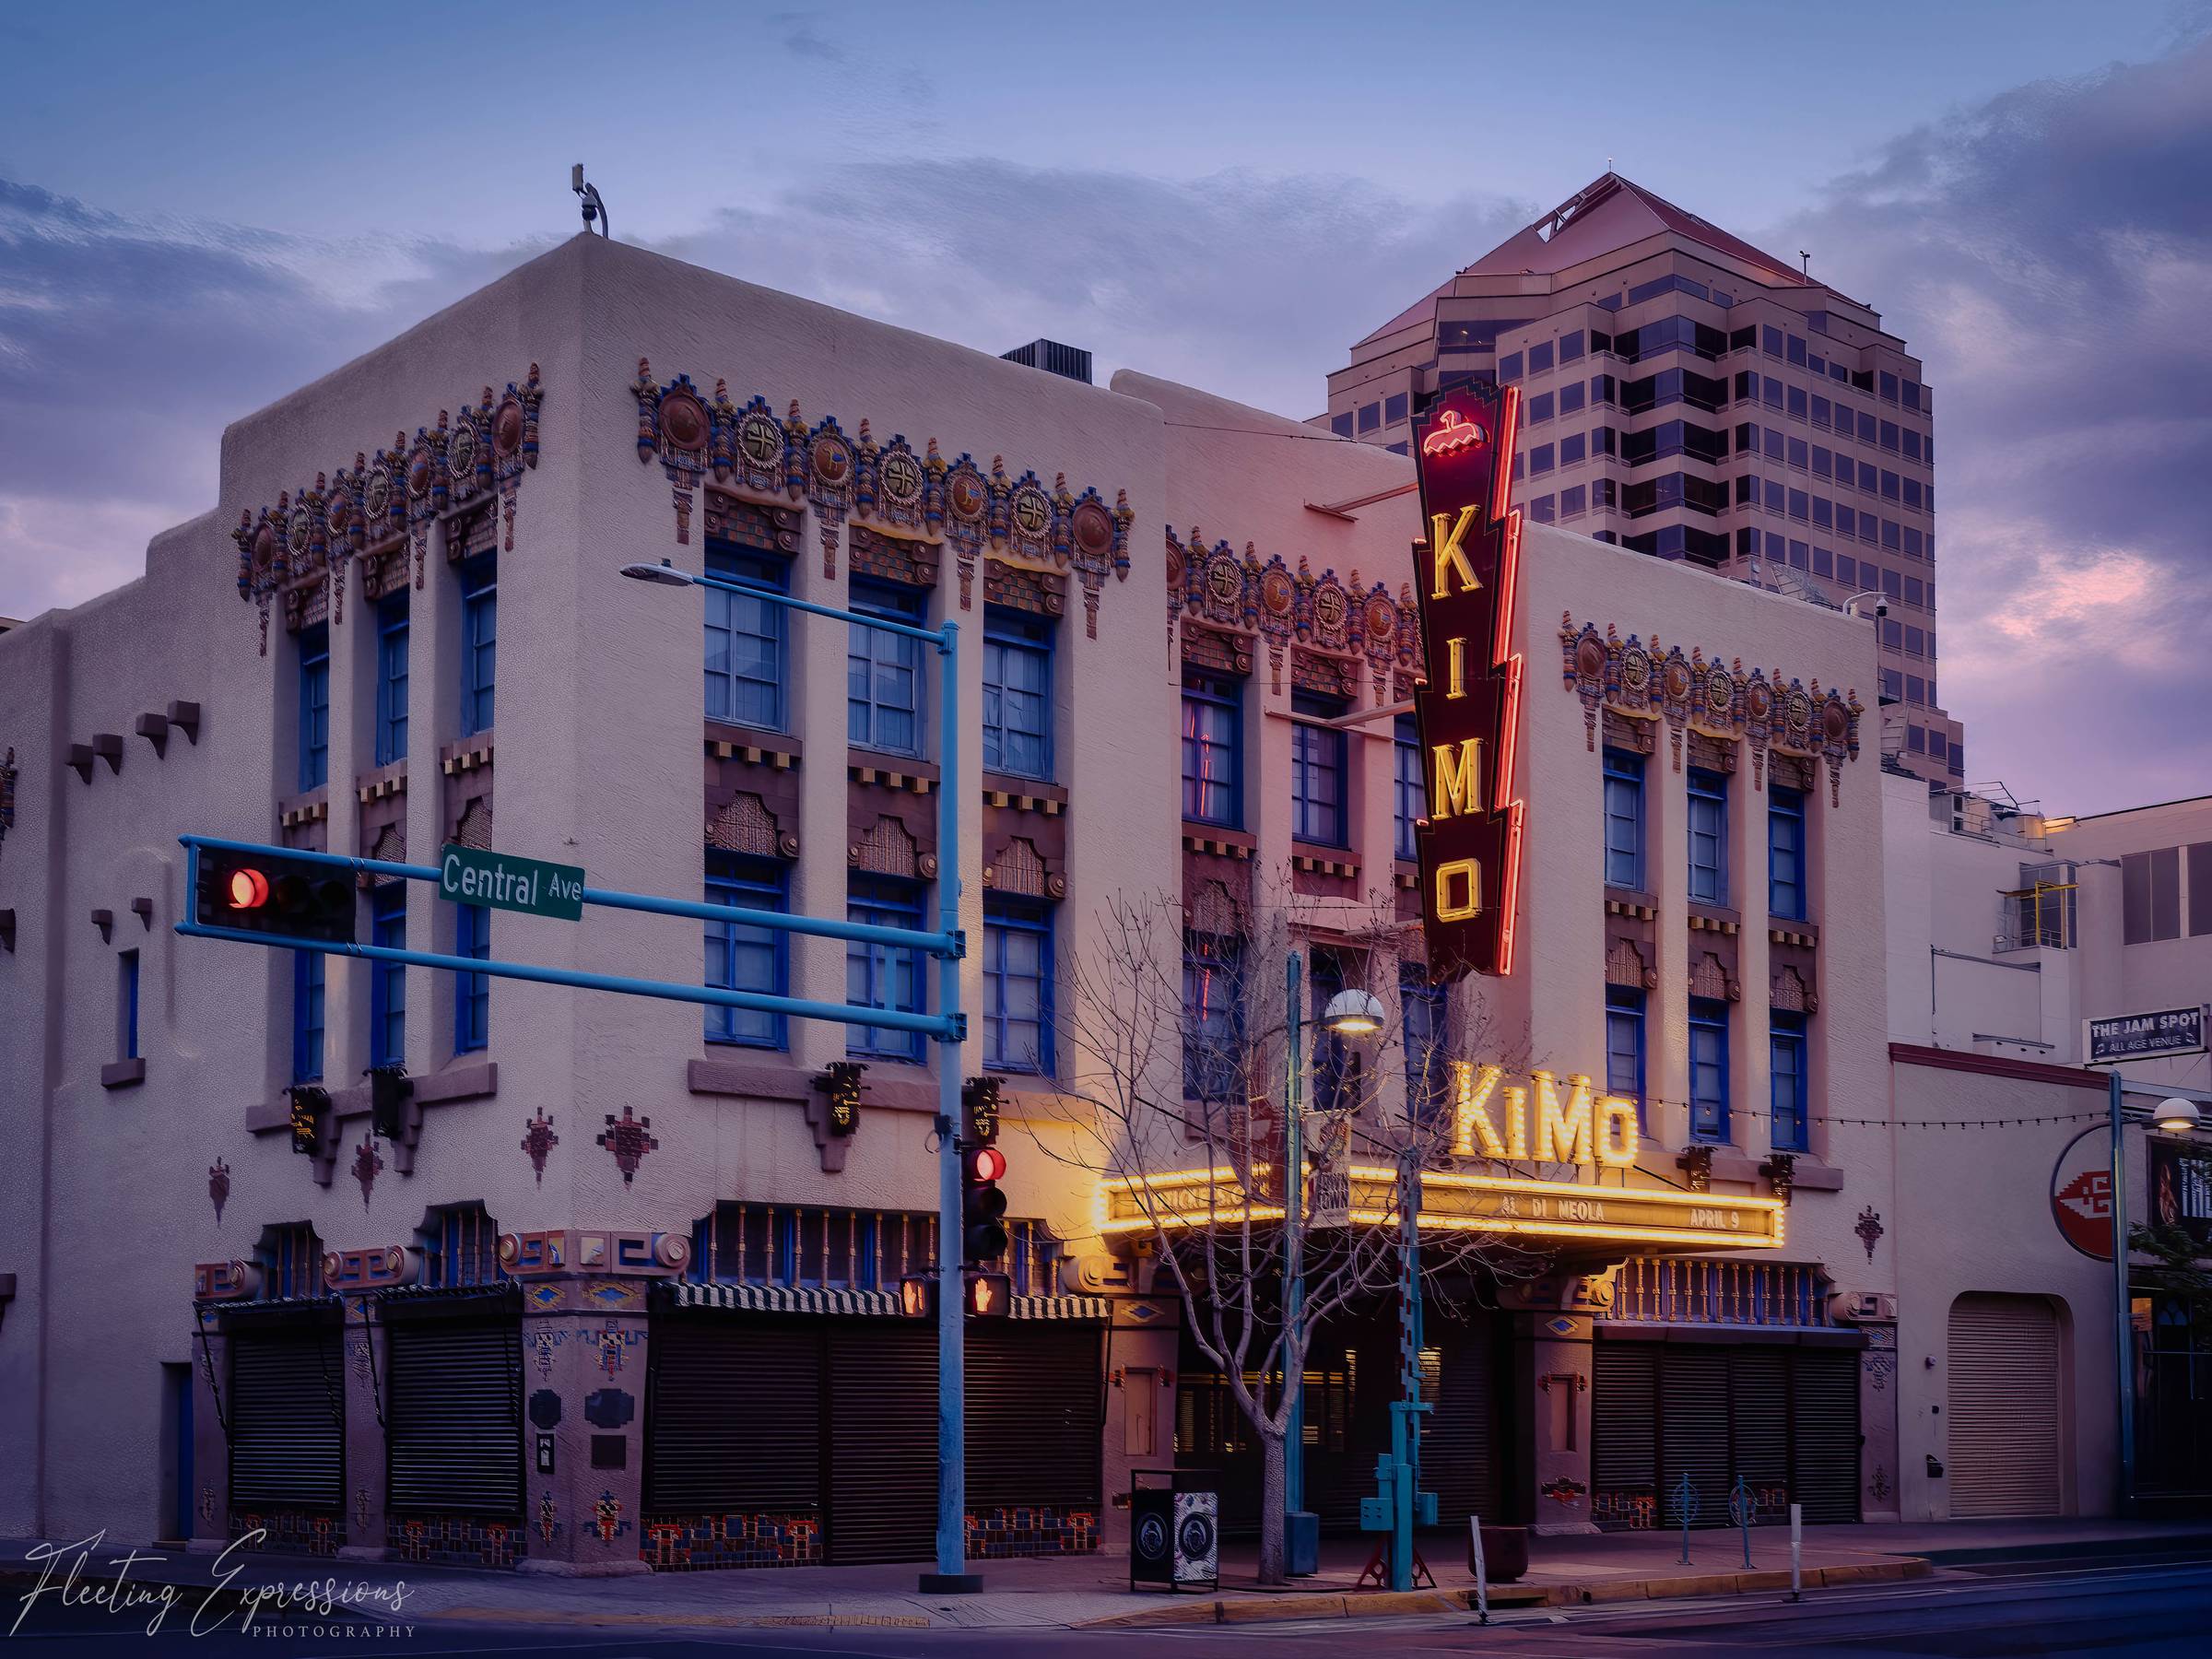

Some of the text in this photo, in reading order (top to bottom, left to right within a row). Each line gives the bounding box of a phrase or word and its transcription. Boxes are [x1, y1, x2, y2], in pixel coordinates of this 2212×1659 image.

[443, 853, 582, 907] Central Ave
[2091, 1012, 2199, 1038] THE JAM SPOT
[2109, 1041, 2125, 1053] ALL
[2148, 1035, 2182, 1047] VENUE
[1532, 1197, 1547, 1218] DI
[1690, 1208, 1726, 1230] APRIL
